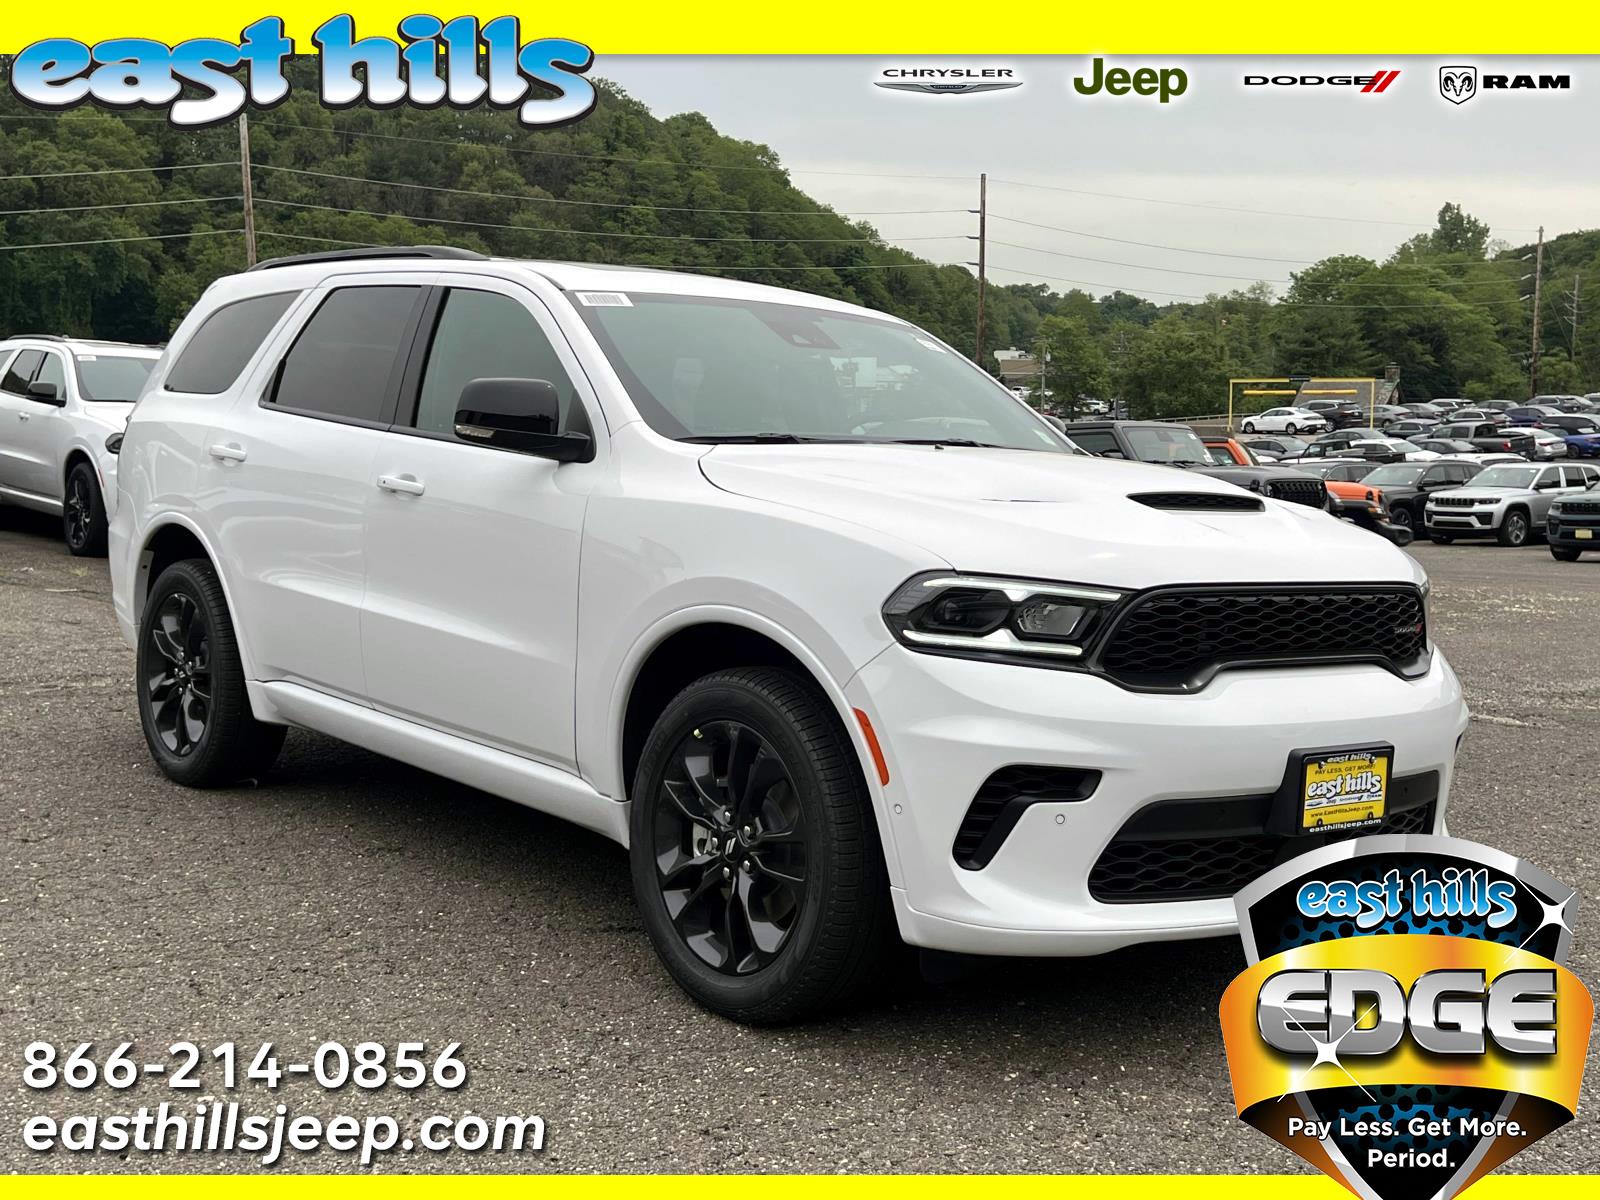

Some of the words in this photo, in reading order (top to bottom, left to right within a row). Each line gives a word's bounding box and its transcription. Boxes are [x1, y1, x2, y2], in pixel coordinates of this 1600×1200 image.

[1307, 774, 1344, 799] east
[1345, 771, 1382, 794] hills
[1309, 819, 1382, 833] easthillsjeep.com
